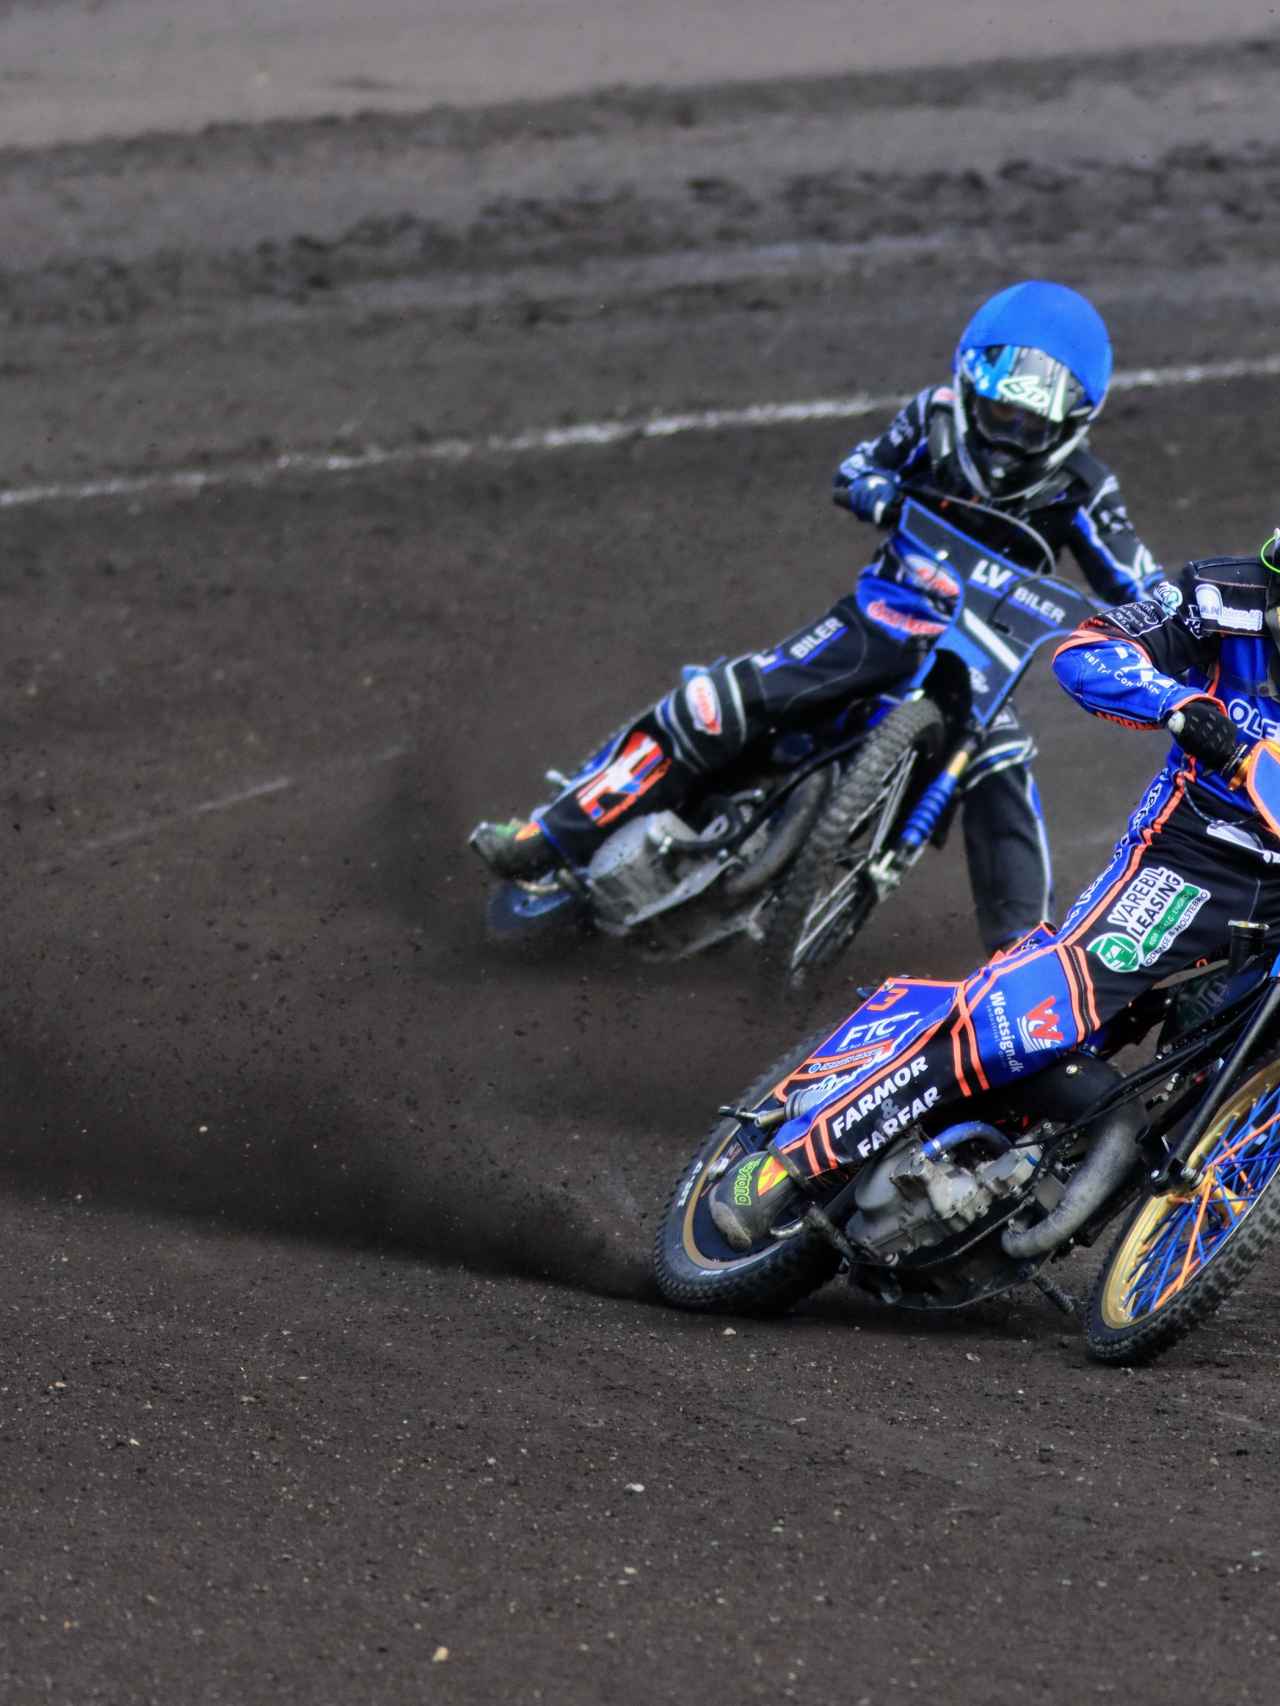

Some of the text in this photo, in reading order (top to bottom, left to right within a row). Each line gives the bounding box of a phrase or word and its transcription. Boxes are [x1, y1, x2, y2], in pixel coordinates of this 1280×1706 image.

[970, 559, 1012, 589] LV
[1012, 586, 1067, 625] BILER
[790, 616, 844, 659] BILER
[1111, 868, 1164, 924] VAREBIL
[1130, 874, 1181, 943] LEASING
[839, 1018, 899, 1048] FTC
[989, 991, 1025, 1074] Westsign.dk
[831, 1055, 929, 1140] FARMOR
[856, 1085, 942, 1160] FARFAR
